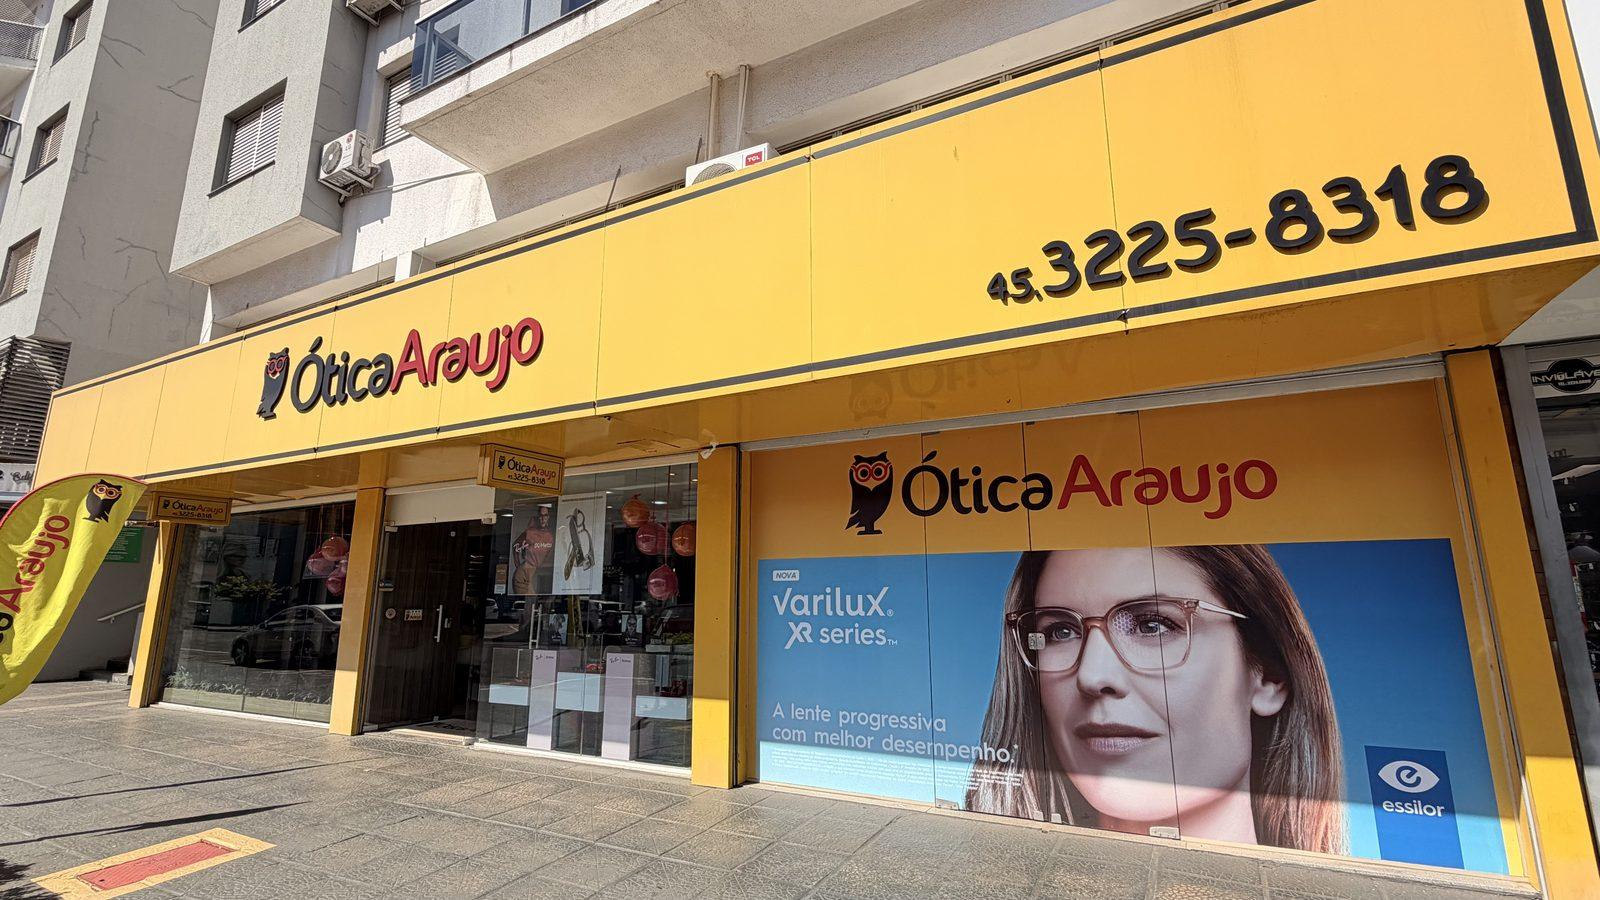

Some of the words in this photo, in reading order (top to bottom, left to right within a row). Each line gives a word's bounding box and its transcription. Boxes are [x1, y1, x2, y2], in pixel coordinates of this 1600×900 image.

[0, 515, 70, 614] Araujo
[784, 621, 814, 649] XR
[772, 701, 785, 719] A
[791, 703, 831, 723] lente
[838, 709, 946, 732] progressiva
[772, 727, 806, 743] com
[814, 729, 874, 750] melhor
[1382, 800, 1445, 817] essilor
